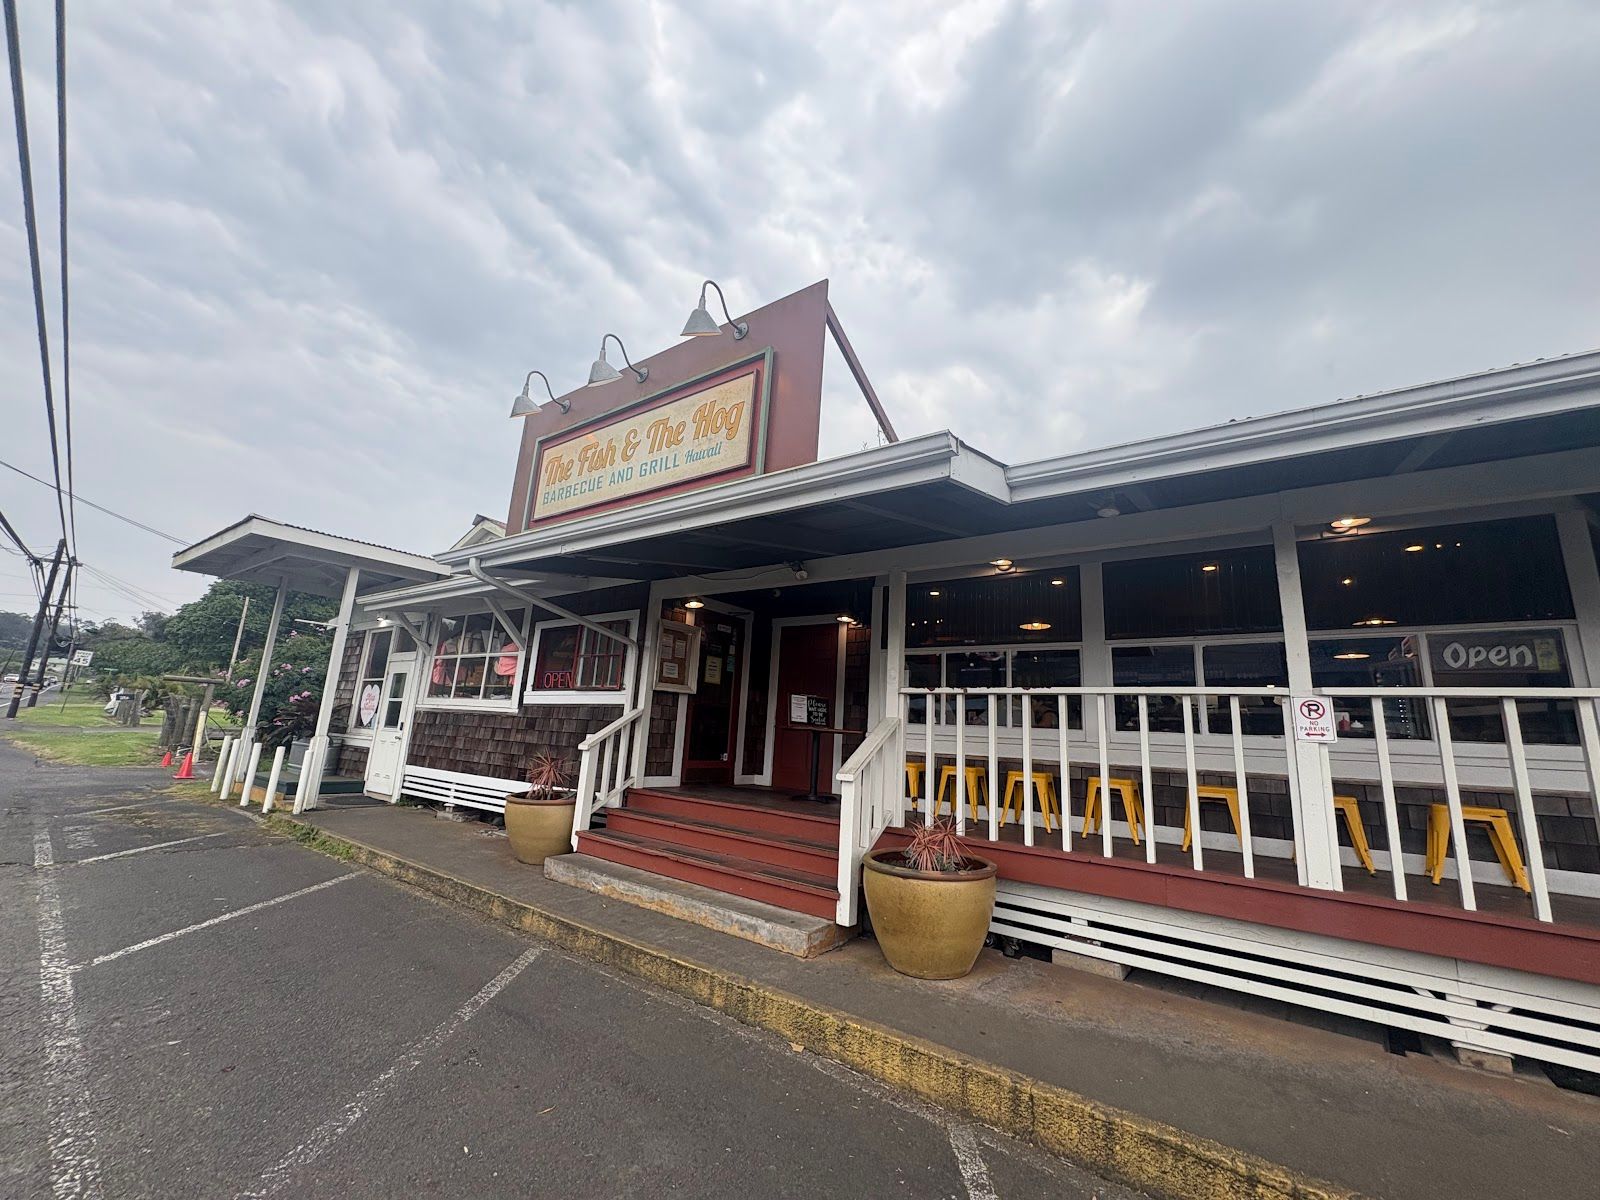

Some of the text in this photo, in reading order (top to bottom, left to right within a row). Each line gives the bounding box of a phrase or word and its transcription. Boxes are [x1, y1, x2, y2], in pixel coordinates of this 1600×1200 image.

[545, 400, 745, 486] The Fish & The Hog
[542, 442, 722, 505] BARBECUE AND GRILL Hawaii
[1442, 642, 1533, 669] Open
[544, 672, 573, 688] OPEN
